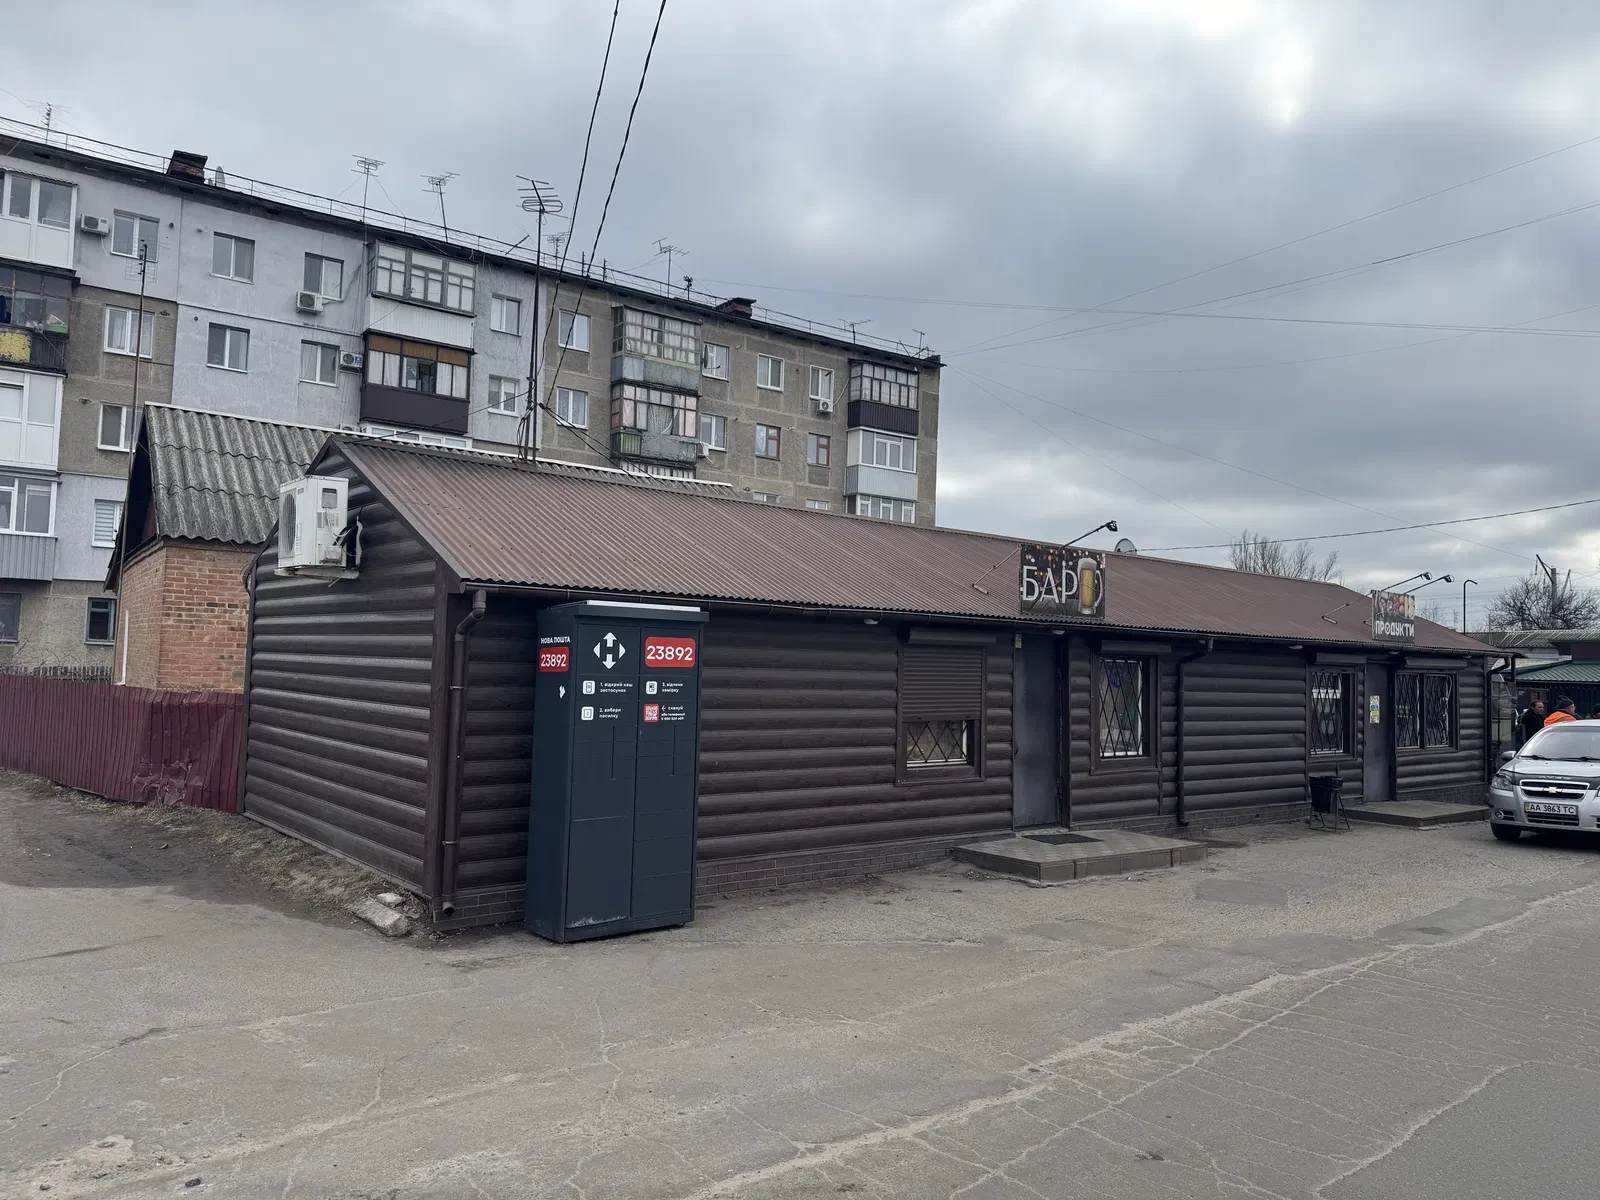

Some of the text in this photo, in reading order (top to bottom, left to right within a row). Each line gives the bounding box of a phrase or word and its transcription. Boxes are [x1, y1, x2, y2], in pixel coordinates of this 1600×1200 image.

[1023, 565, 1078, 603] БАР
[1375, 620, 1415, 637] ПРОДУКТИ
[646, 646, 693, 660] 23892
[540, 654, 566, 667] 23892
[1530, 804, 1575, 814] AA 3863 TC
